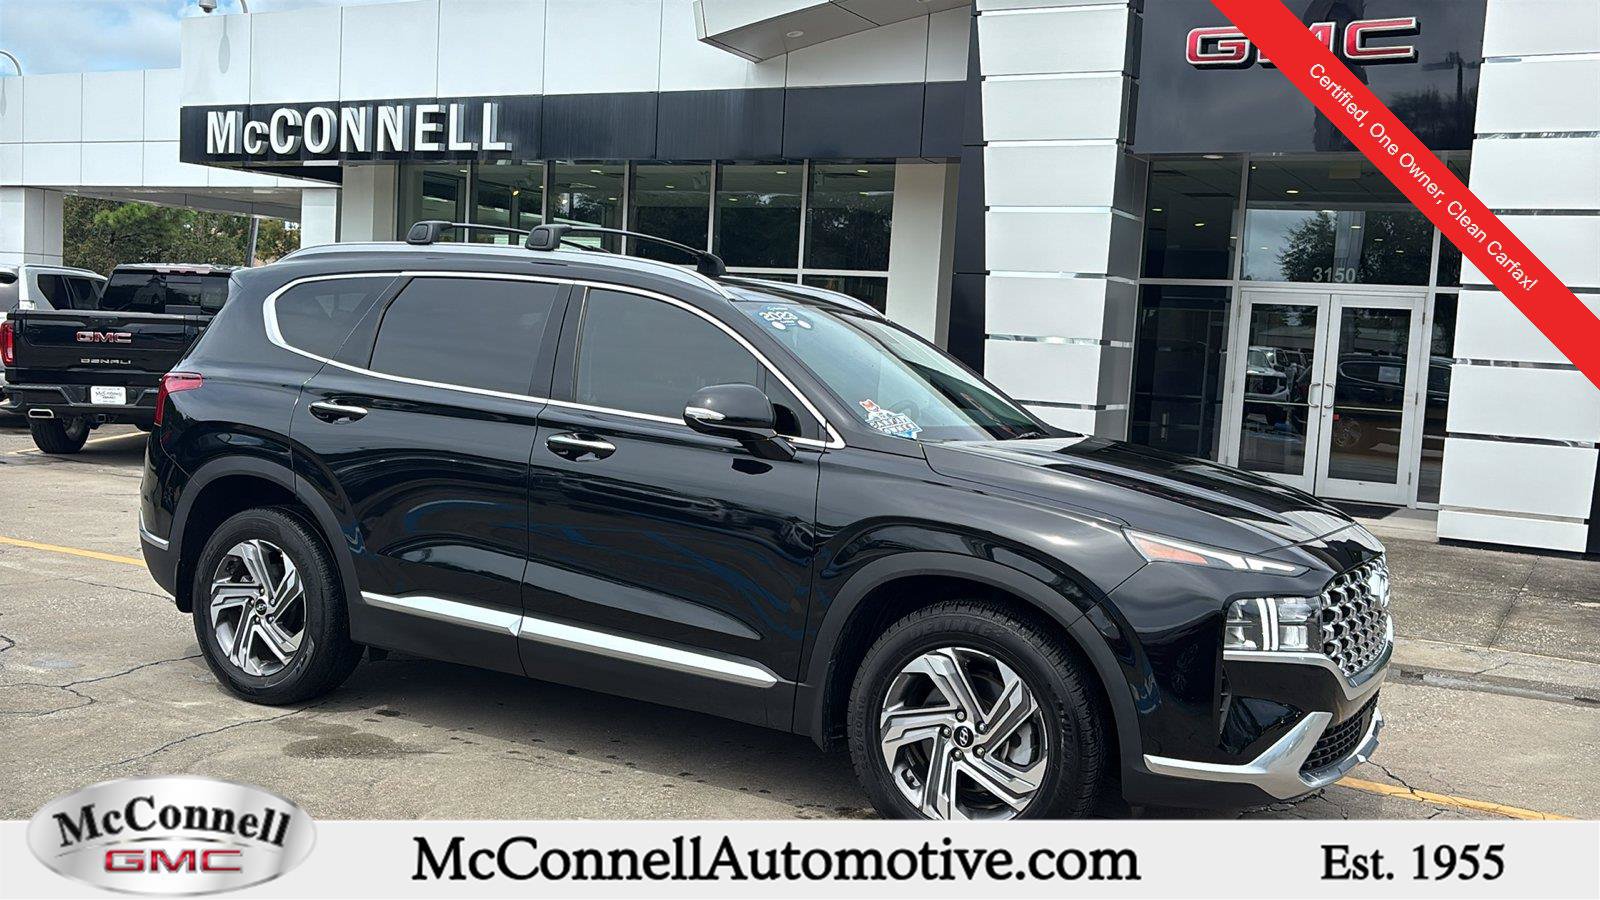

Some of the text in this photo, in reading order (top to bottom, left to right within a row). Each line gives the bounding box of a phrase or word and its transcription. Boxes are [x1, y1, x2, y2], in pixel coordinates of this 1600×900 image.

[206, 102, 512, 155] McCONNELL
[1312, 266, 1356, 283] 3150
[76, 331, 132, 343] GMC
